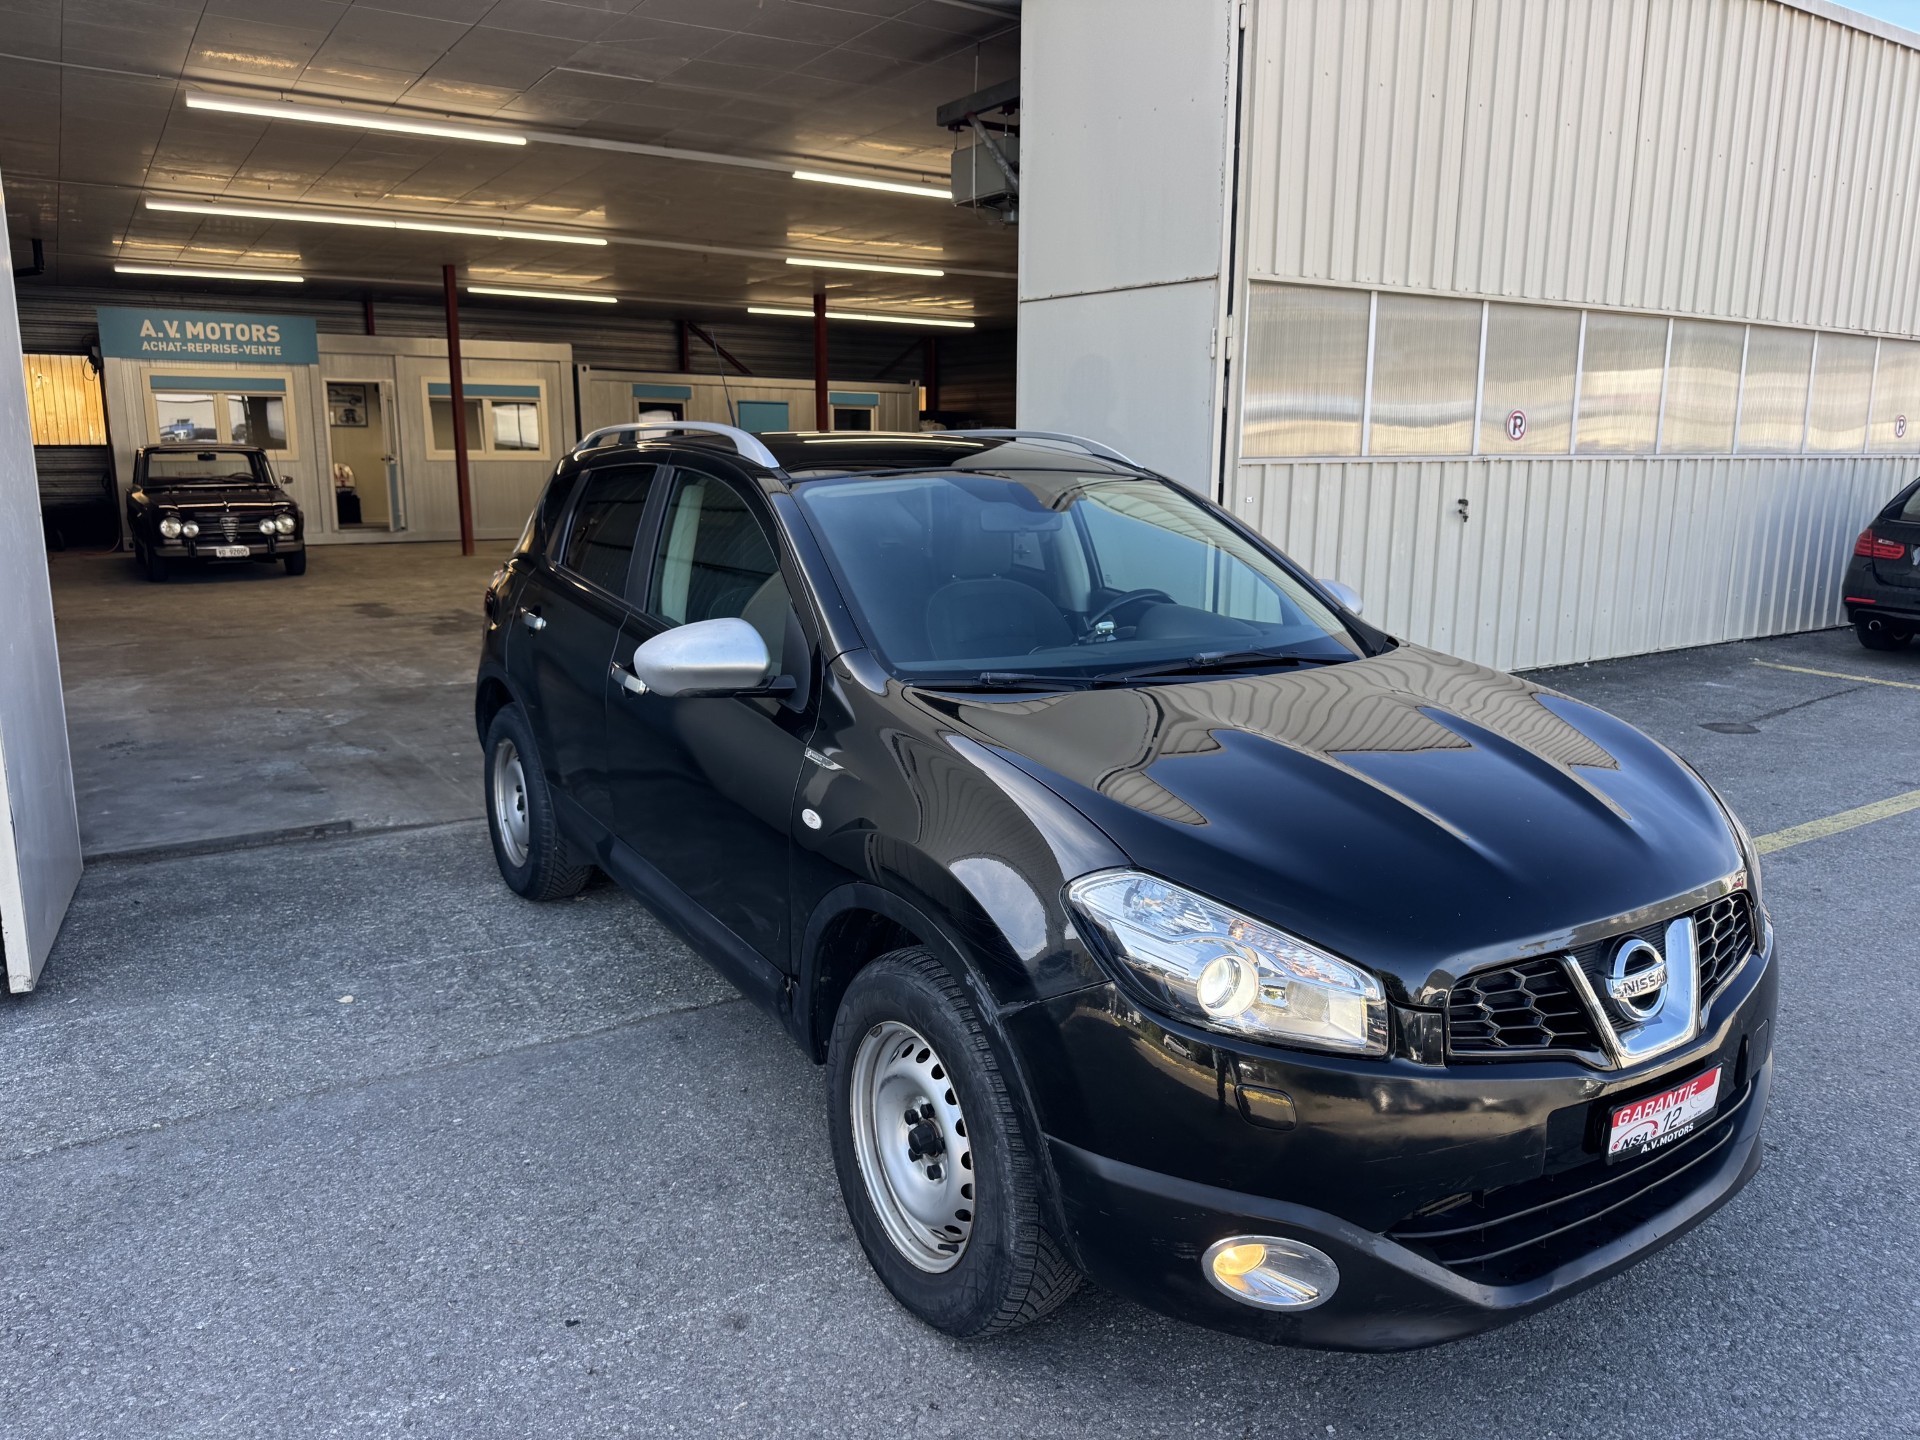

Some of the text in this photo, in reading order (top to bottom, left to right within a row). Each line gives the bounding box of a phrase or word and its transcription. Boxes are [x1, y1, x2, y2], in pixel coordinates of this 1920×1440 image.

[140, 319, 280, 342] A.V. MOTORS
[142, 341, 281, 356] ACHAT-REPRISE-VENTE
[1623, 970, 1668, 993] NISSAN
[1618, 1081, 1699, 1126] GARANTIE
[1662, 1106, 1683, 1133] 12
[1621, 1131, 1649, 1150] NSA
